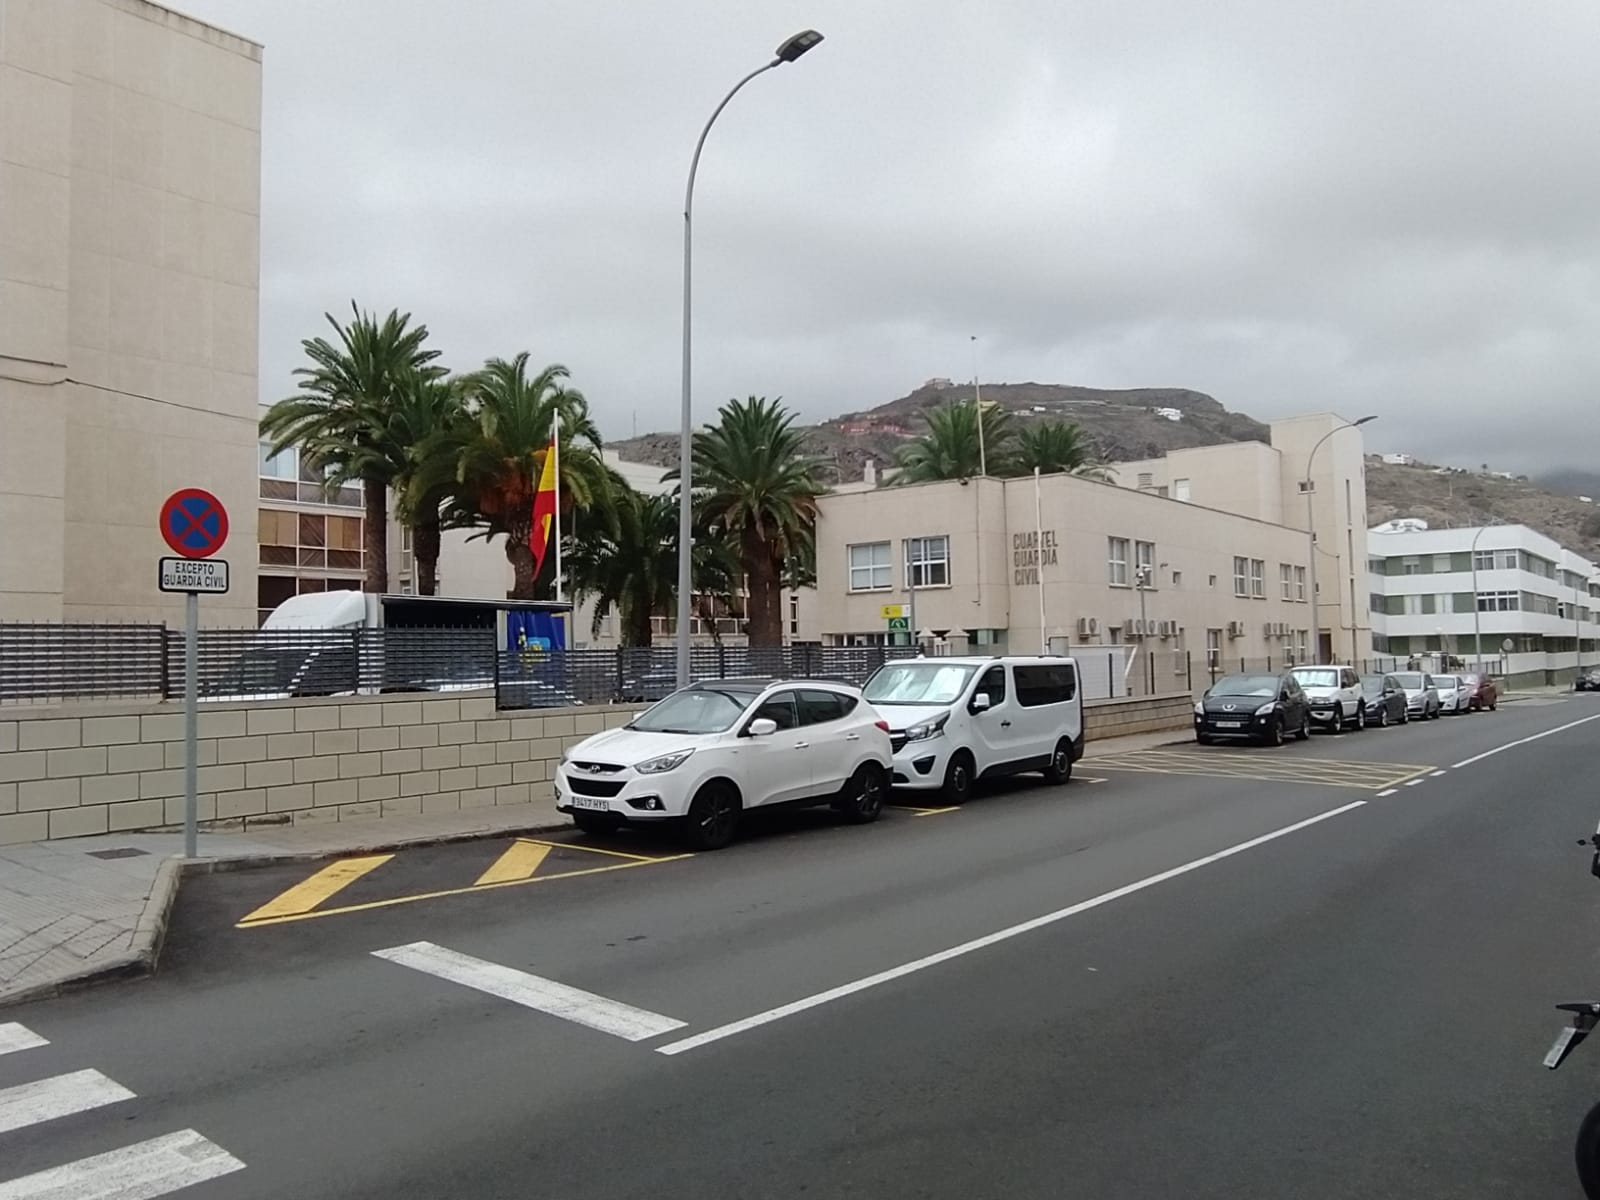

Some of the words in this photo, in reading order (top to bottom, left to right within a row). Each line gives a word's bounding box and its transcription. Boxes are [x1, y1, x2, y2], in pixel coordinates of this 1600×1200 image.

[1013, 531, 1058, 550] CUARTEL
[1014, 549, 1058, 567] GUARDIA
[175, 562, 214, 575] EXCEPTO
[1014, 568, 1040, 586] CIVIL
[164, 574, 202, 587] GUARDIA
[204, 576, 225, 588] CIVIL
